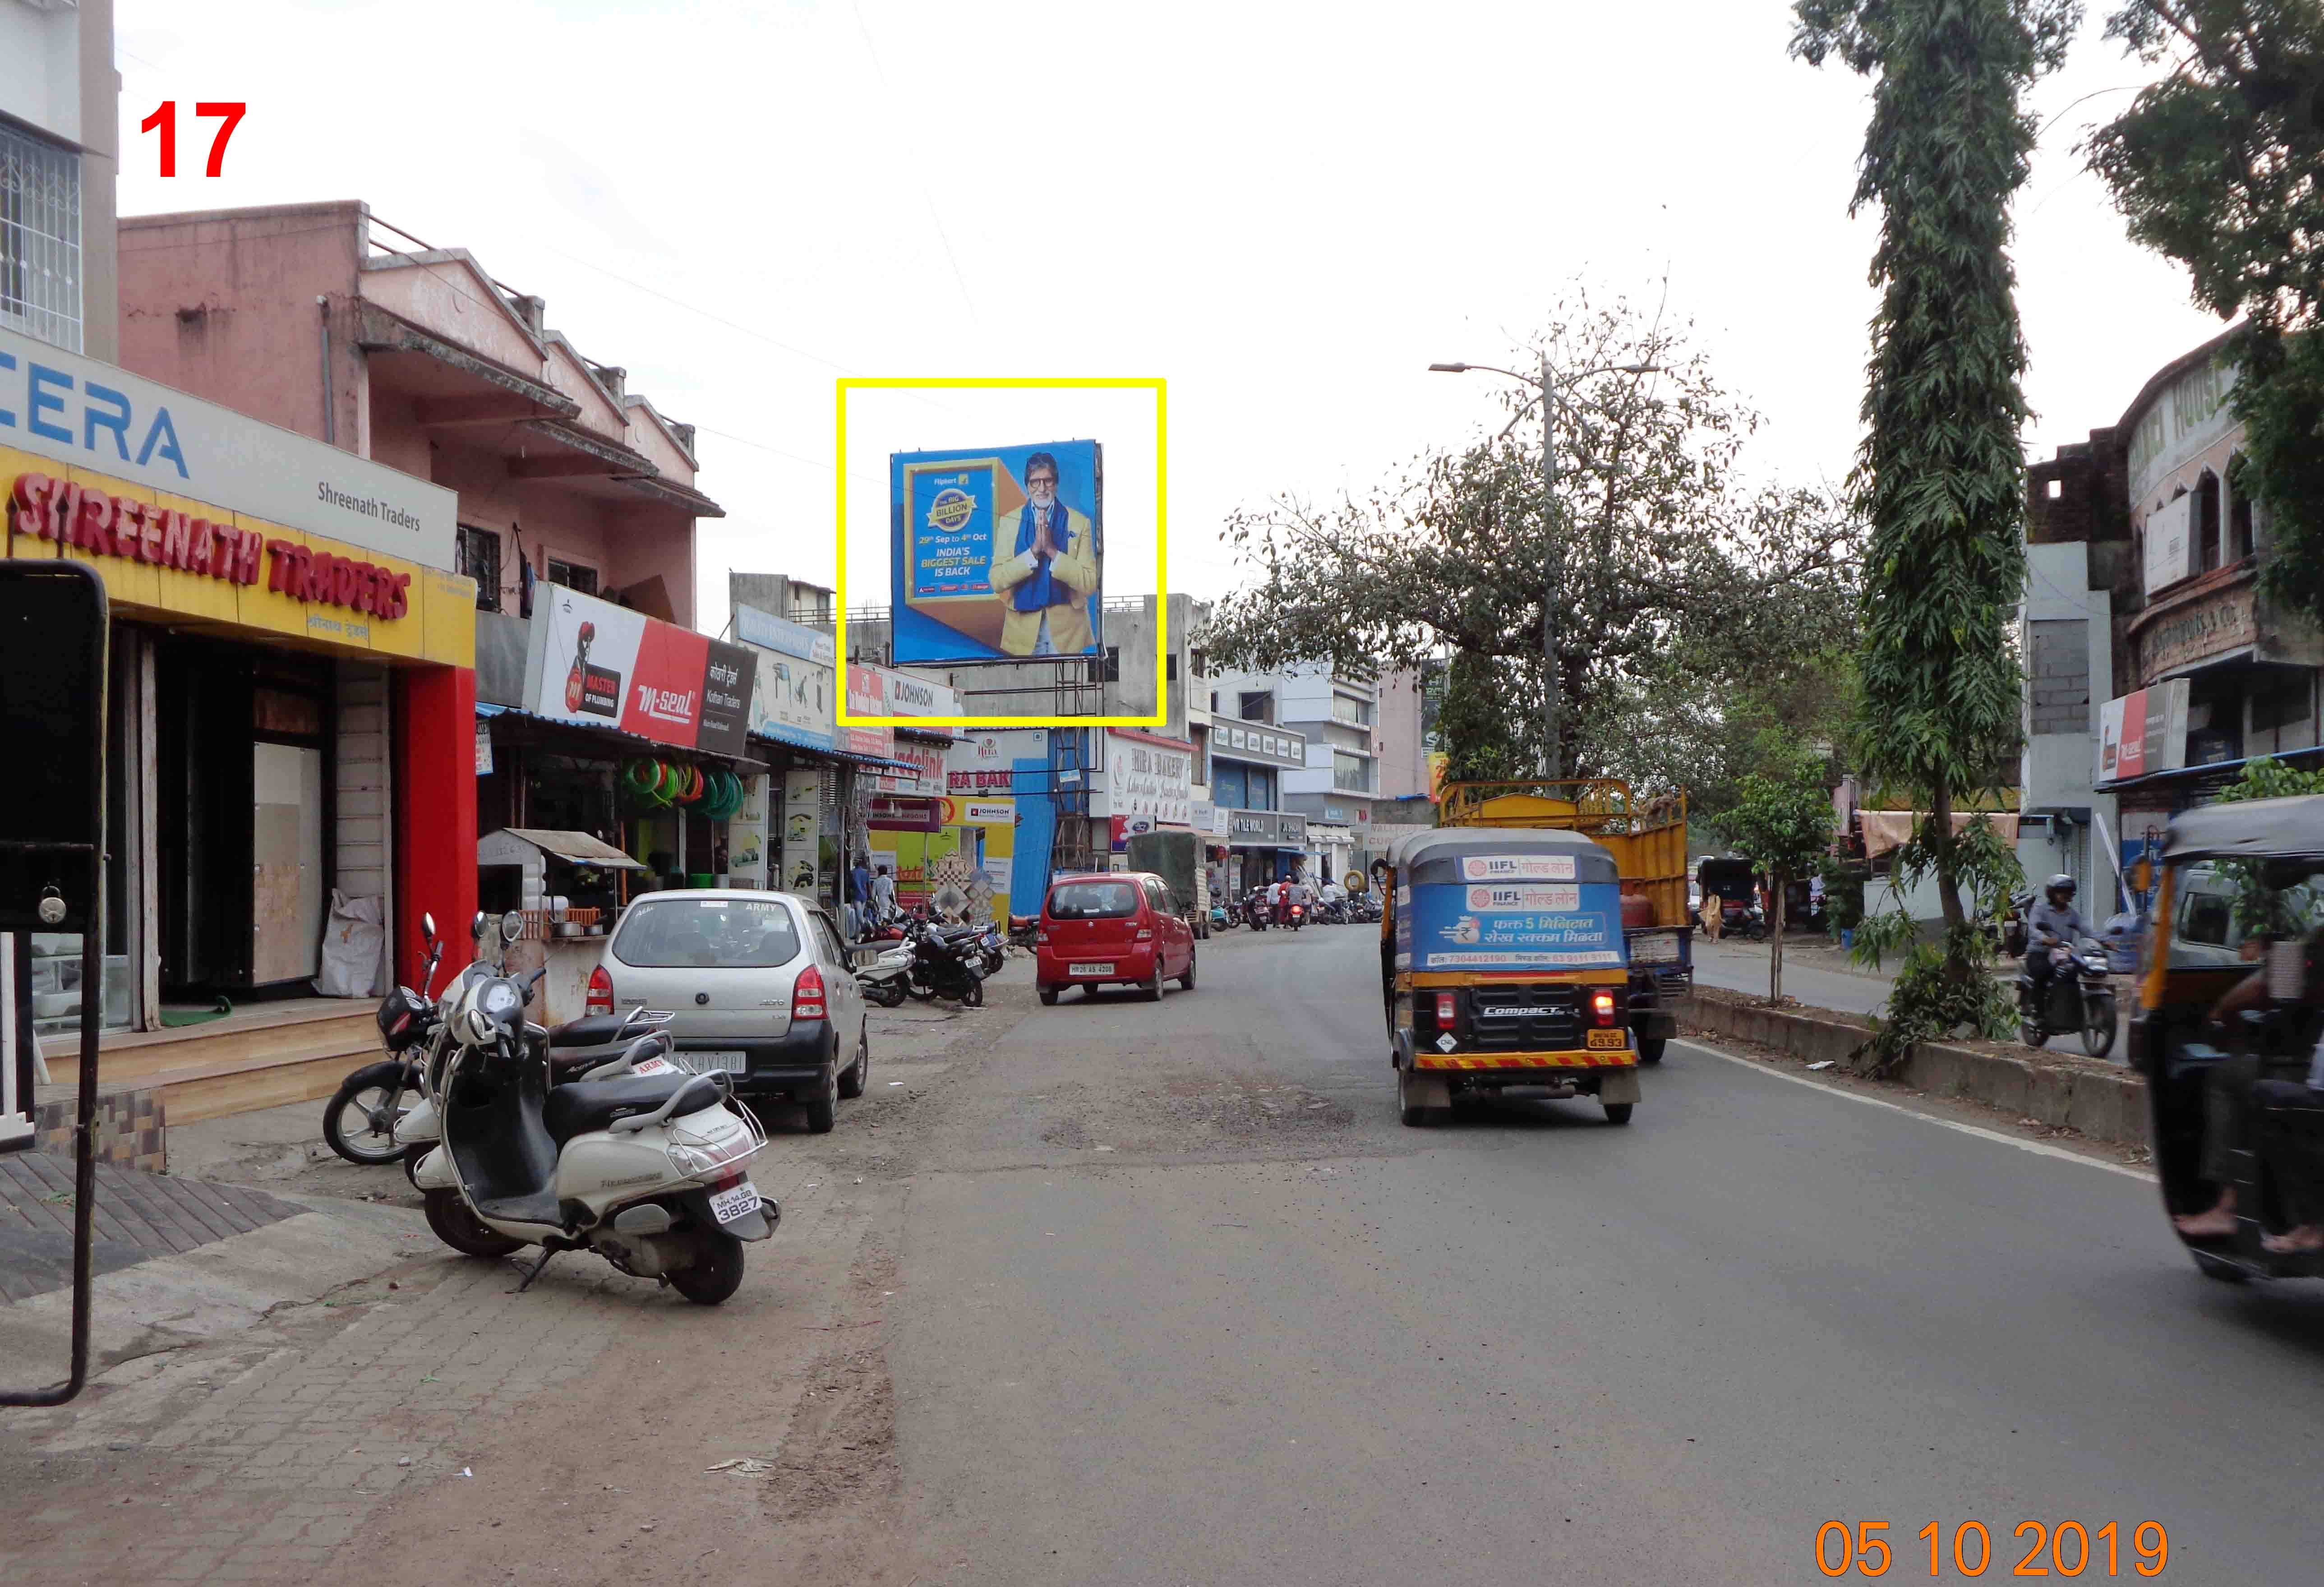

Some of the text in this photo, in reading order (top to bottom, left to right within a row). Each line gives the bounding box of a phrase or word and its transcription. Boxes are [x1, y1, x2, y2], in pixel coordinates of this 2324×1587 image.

[318, 481, 420, 532] Shreenath Traders
[936, 503, 968, 517] BILLION
[945, 516, 961, 524] DAYS
[13, 473, 411, 620] SHREENATH TRADERS
[935, 535, 950, 544] Sep
[936, 547, 970, 557] INDIA'S
[921, 555, 986, 568] BIGGEST SALE
[935, 567, 970, 577] IS BACK
[586, 675, 617, 694] MASTER
[585, 693, 614, 708] OF PLUMBING
[724, 693, 740, 709] Traders
[901, 683, 933, 708] JOHNSON
[1249, 818, 1264, 833] WORLD
[1489, 861, 1517, 870] IIFL
[1521, 858, 1573, 874] गोल्ड लोन
[1493, 891, 1521, 901] IIFL
[1525, 888, 1577, 906] गोल्ड लोन
[746, 903, 777, 912] ARMY
[1526, 918, 1534, 929] 5
[638, 1059, 665, 1074] ARMY
[718, 1197, 758, 1221] 3827
